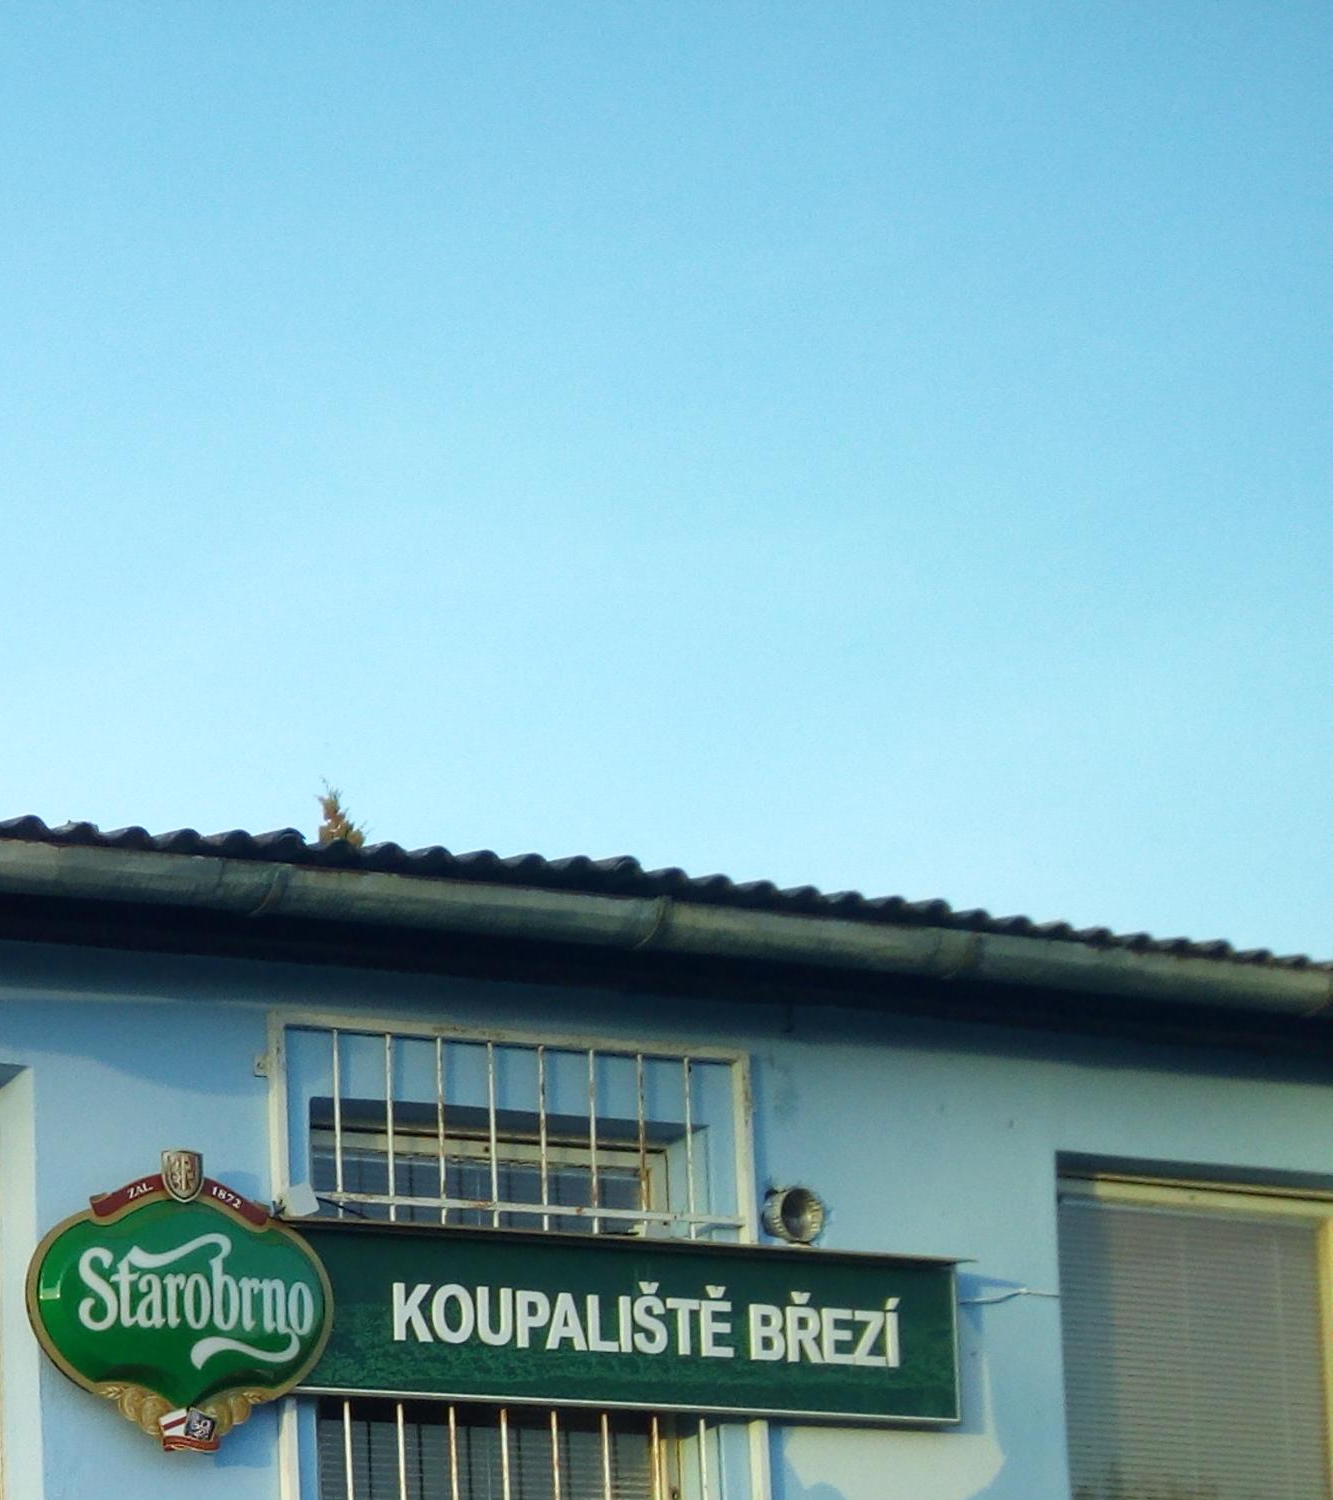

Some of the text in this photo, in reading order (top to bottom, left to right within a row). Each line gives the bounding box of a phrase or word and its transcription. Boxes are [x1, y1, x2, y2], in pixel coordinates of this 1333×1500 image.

[211, 1186, 242, 1210] 1872
[78, 1233, 314, 1370] Starobrno
[392, 1280, 900, 1368] KOUPALIŠTĚ BŘEZÍ
